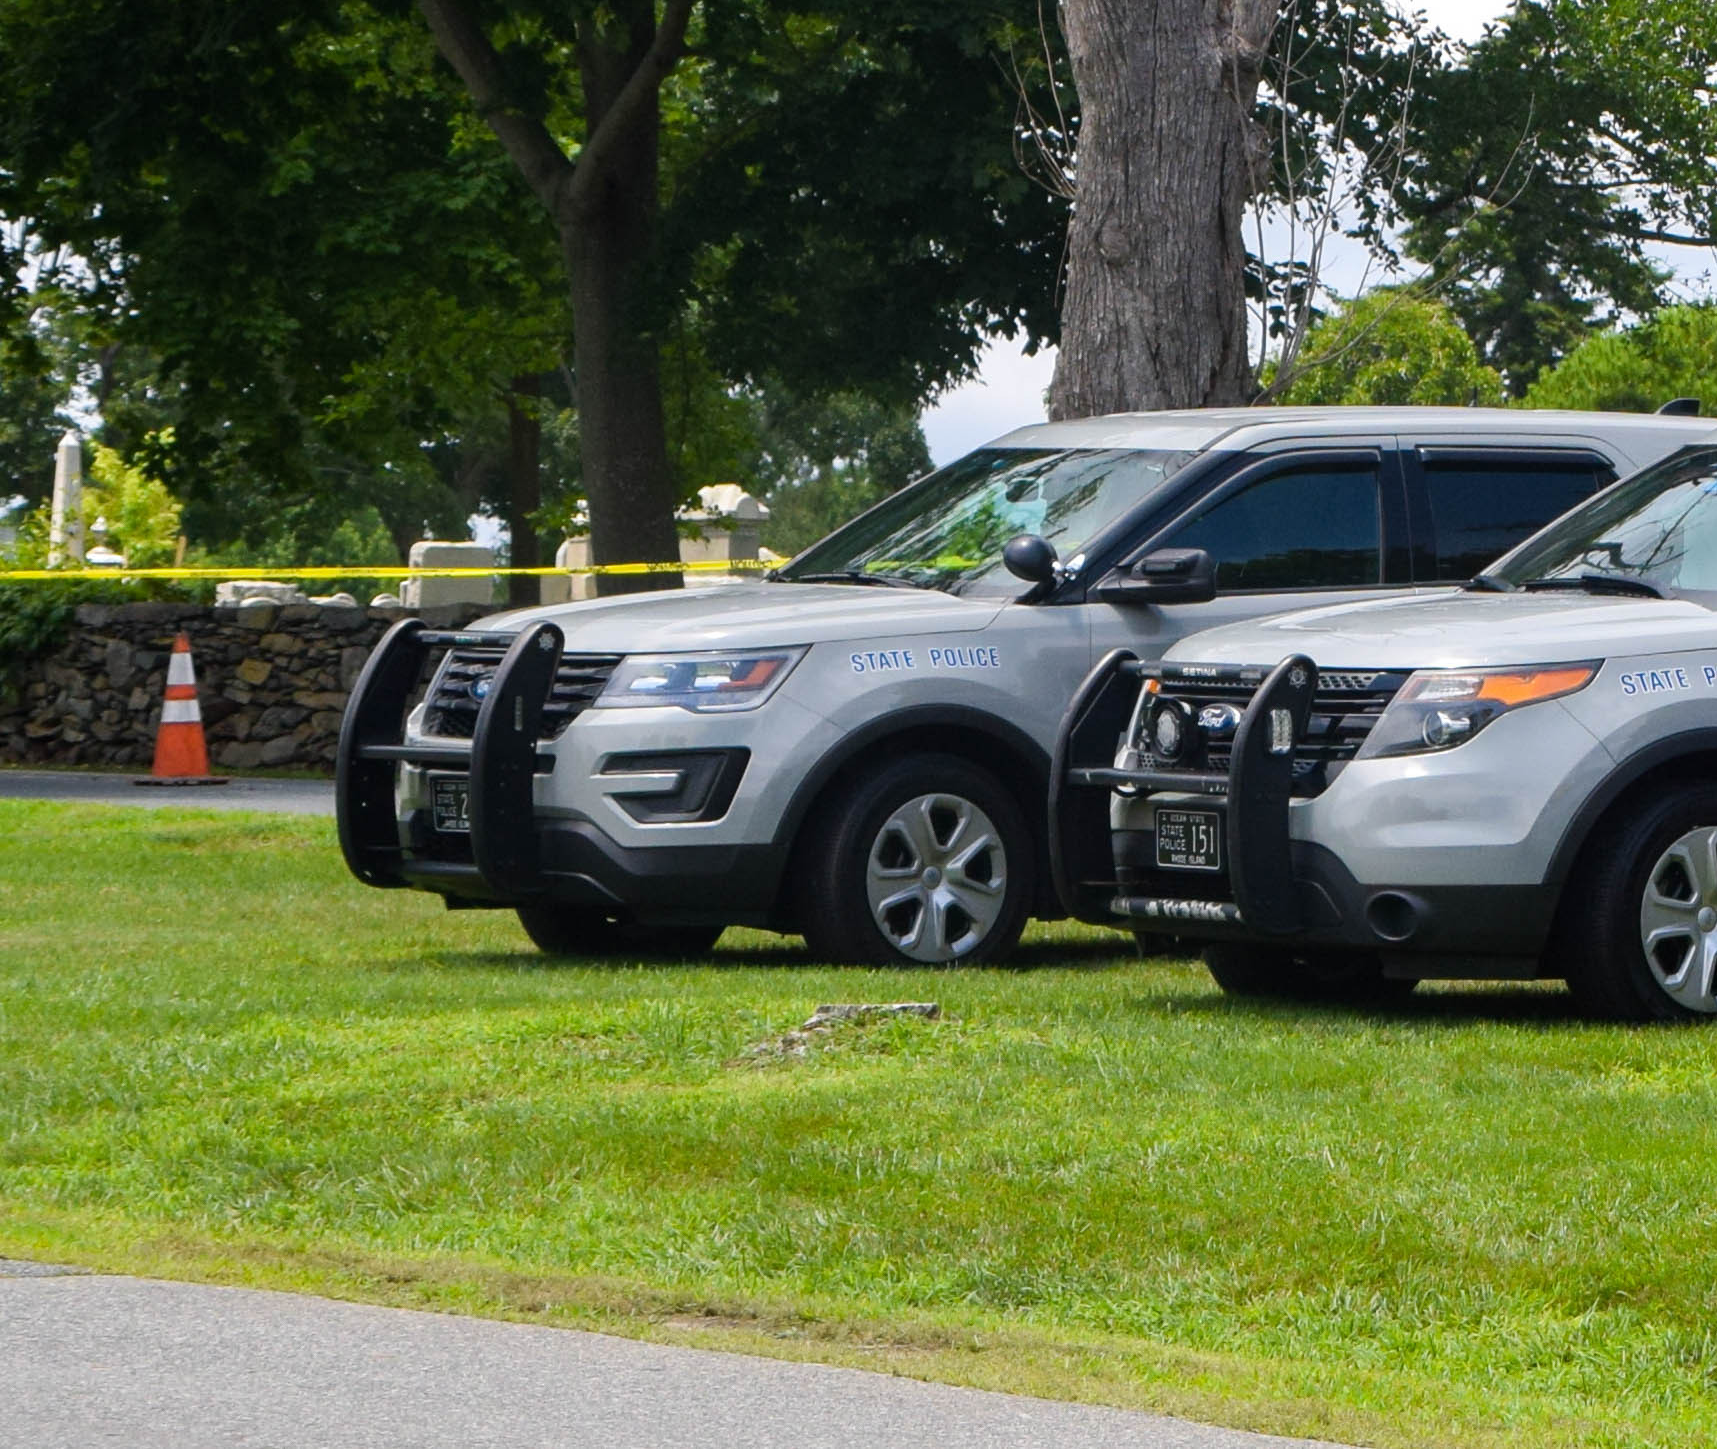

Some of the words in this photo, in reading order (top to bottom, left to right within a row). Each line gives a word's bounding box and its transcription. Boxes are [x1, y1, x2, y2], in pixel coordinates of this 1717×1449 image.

[850, 649, 916, 674] STATE
[928, 646, 1001, 669] POLICE
[1619, 668, 1692, 696] STATE
[1160, 837, 1186, 851] POLICE
[1161, 824, 1184, 837] STATE
[1192, 825, 1214, 854] 151
